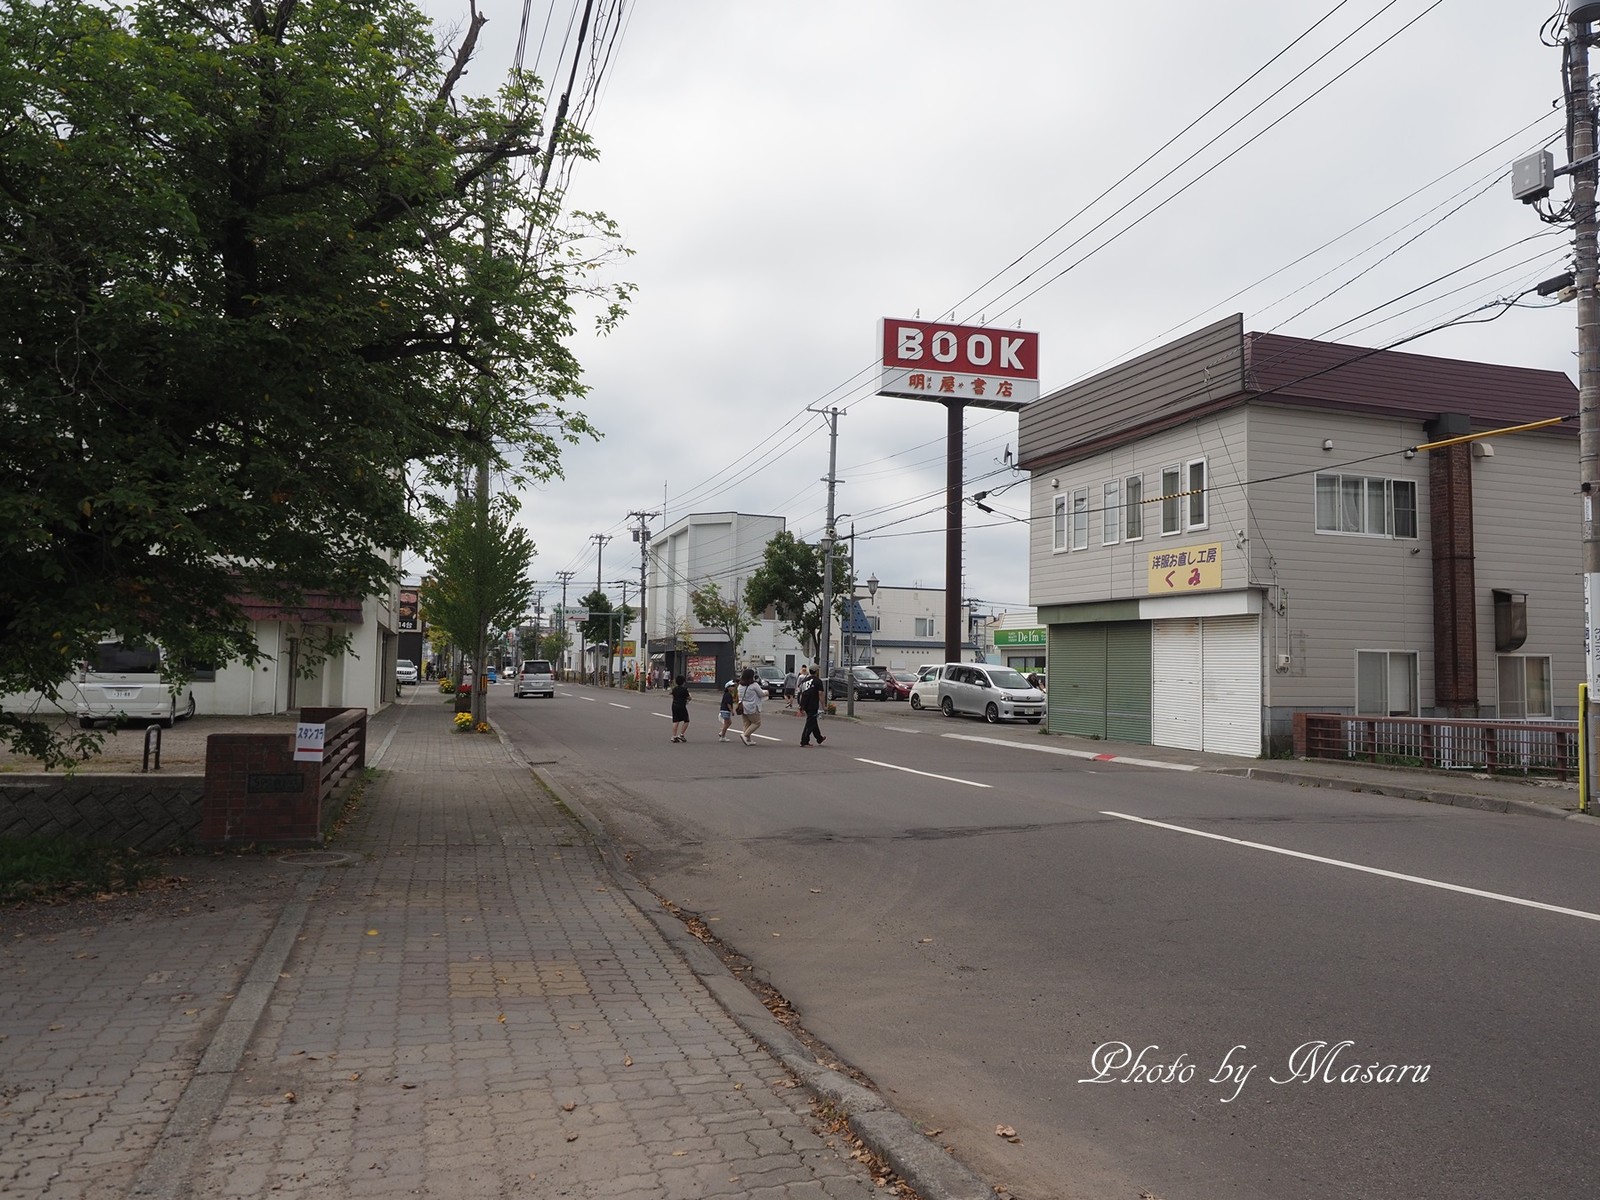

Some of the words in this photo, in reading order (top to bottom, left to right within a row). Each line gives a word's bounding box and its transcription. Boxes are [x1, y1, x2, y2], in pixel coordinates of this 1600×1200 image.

[897, 326, 1025, 370] BOOK
[908, 373, 1013, 398] 明屋書店
[1152, 547, 1218, 569] 洋服お直し工房
[1165, 567, 1201, 588] くみ
